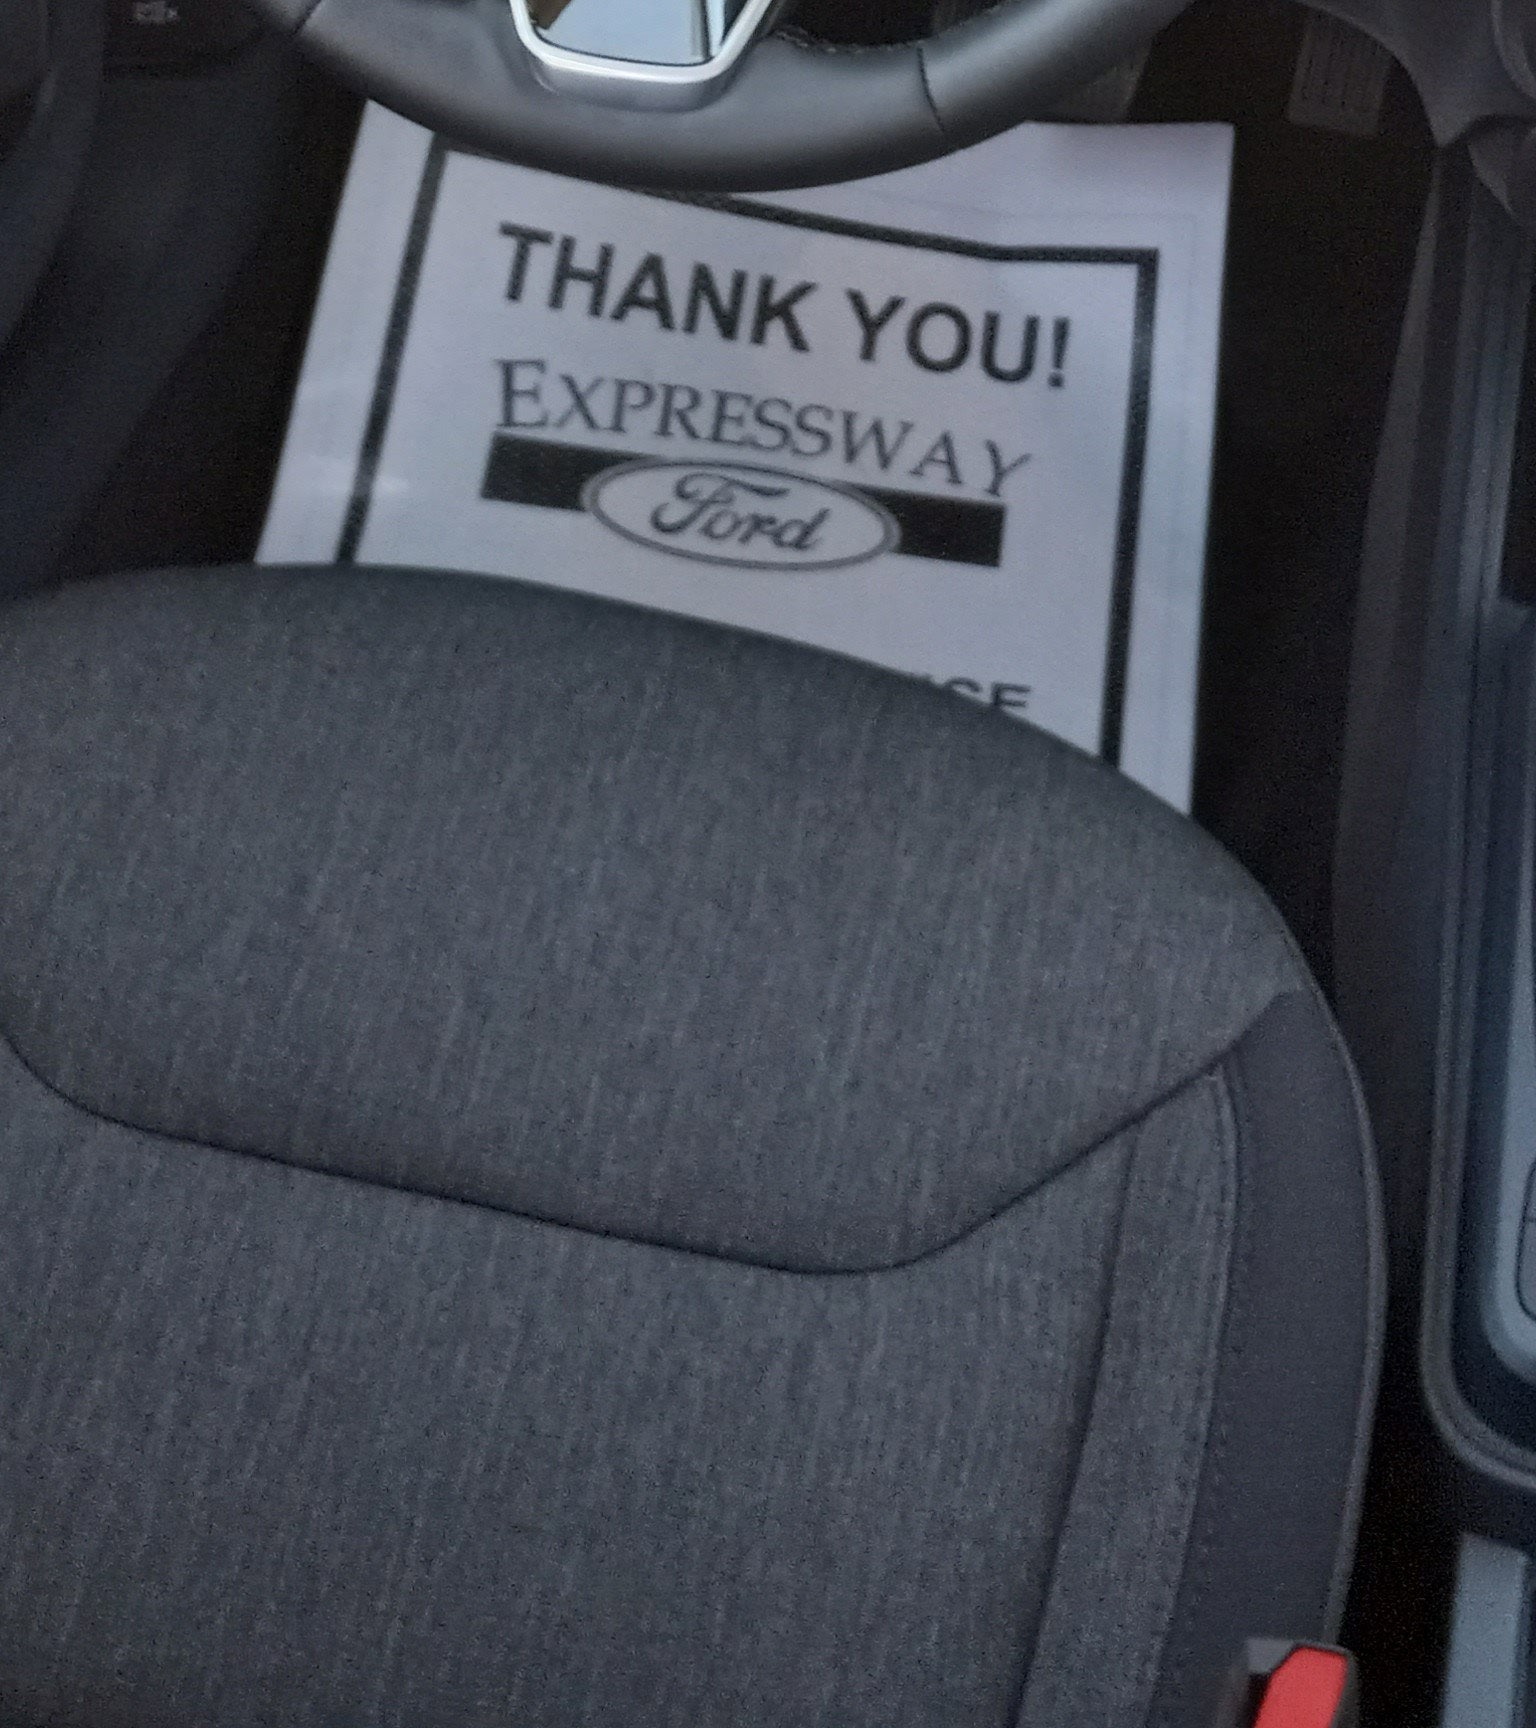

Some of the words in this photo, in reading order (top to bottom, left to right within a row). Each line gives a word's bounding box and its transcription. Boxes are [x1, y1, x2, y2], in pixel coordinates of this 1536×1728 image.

[497, 221, 818, 354] THANK
[843, 288, 1072, 389] YOU!
[495, 357, 1033, 500] EXPRESSWAY
[649, 474, 828, 553] Ford
